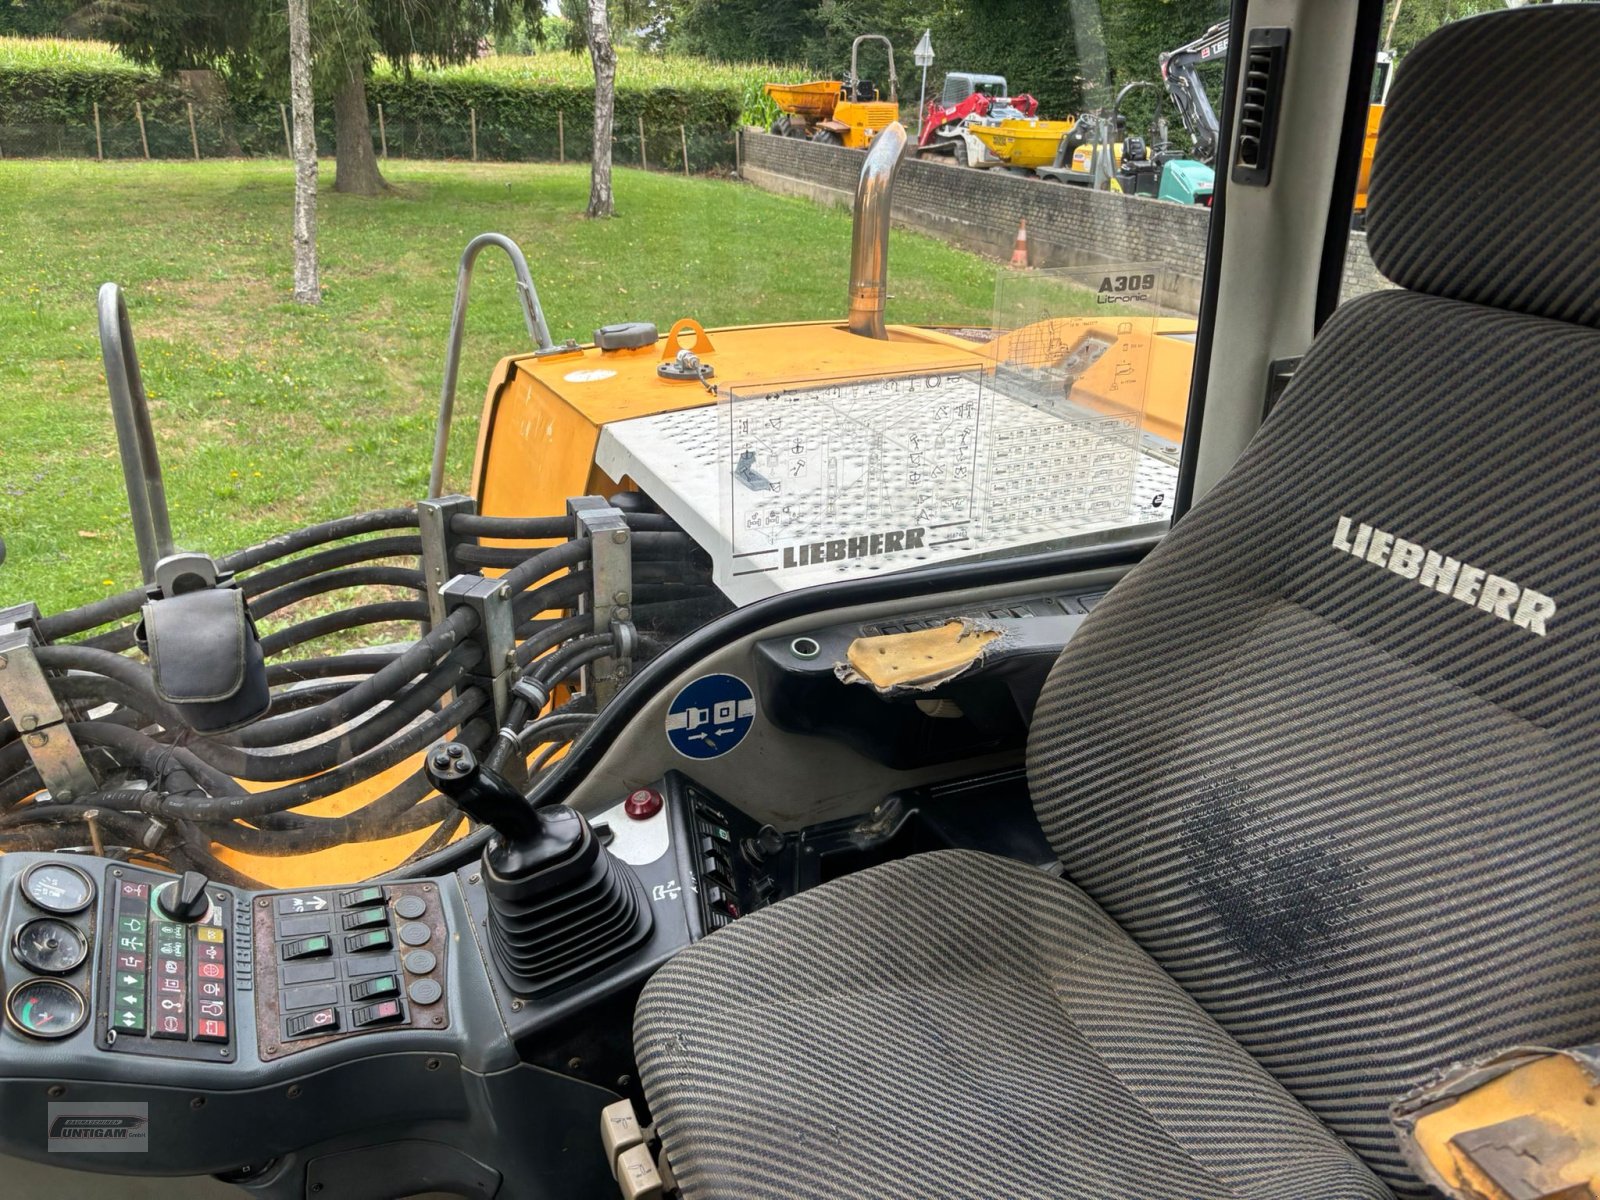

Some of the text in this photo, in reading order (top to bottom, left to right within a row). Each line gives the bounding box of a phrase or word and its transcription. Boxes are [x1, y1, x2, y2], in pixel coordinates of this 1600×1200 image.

[1096, 292, 1148, 305] Litronic
[1098, 274, 1155, 293] A309
[783, 527, 926, 569] LIEBHERR
[1332, 515, 1556, 636] LIEBHERR
